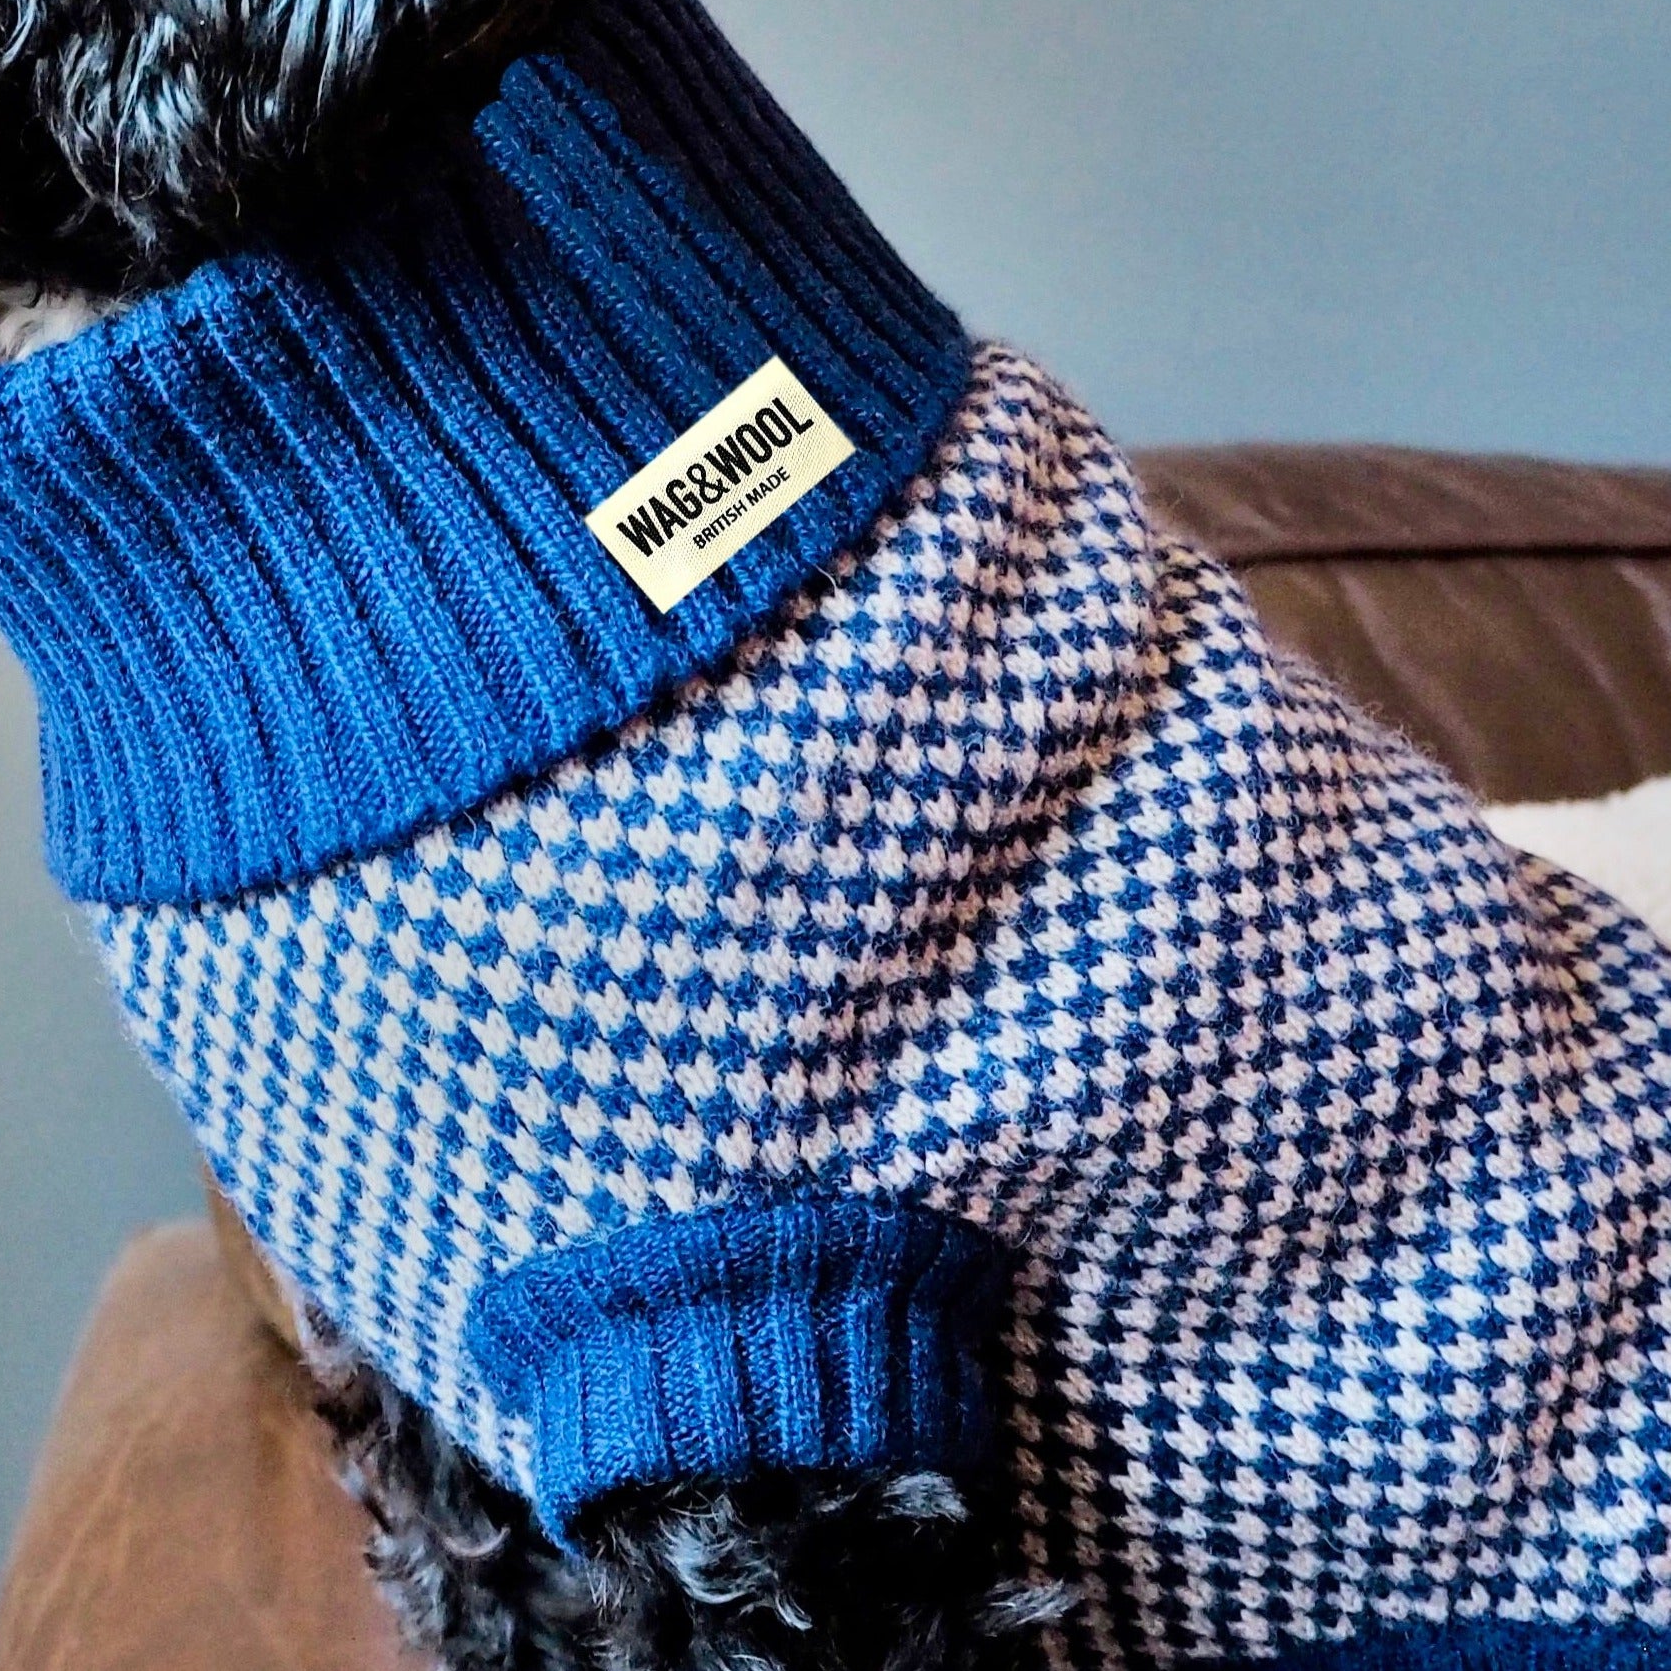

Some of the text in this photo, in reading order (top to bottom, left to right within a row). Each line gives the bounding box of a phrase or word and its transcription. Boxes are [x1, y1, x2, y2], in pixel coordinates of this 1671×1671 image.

[616, 397, 814, 558] WAG&WOOL
[692, 466, 791, 550] BRITISH MADE
